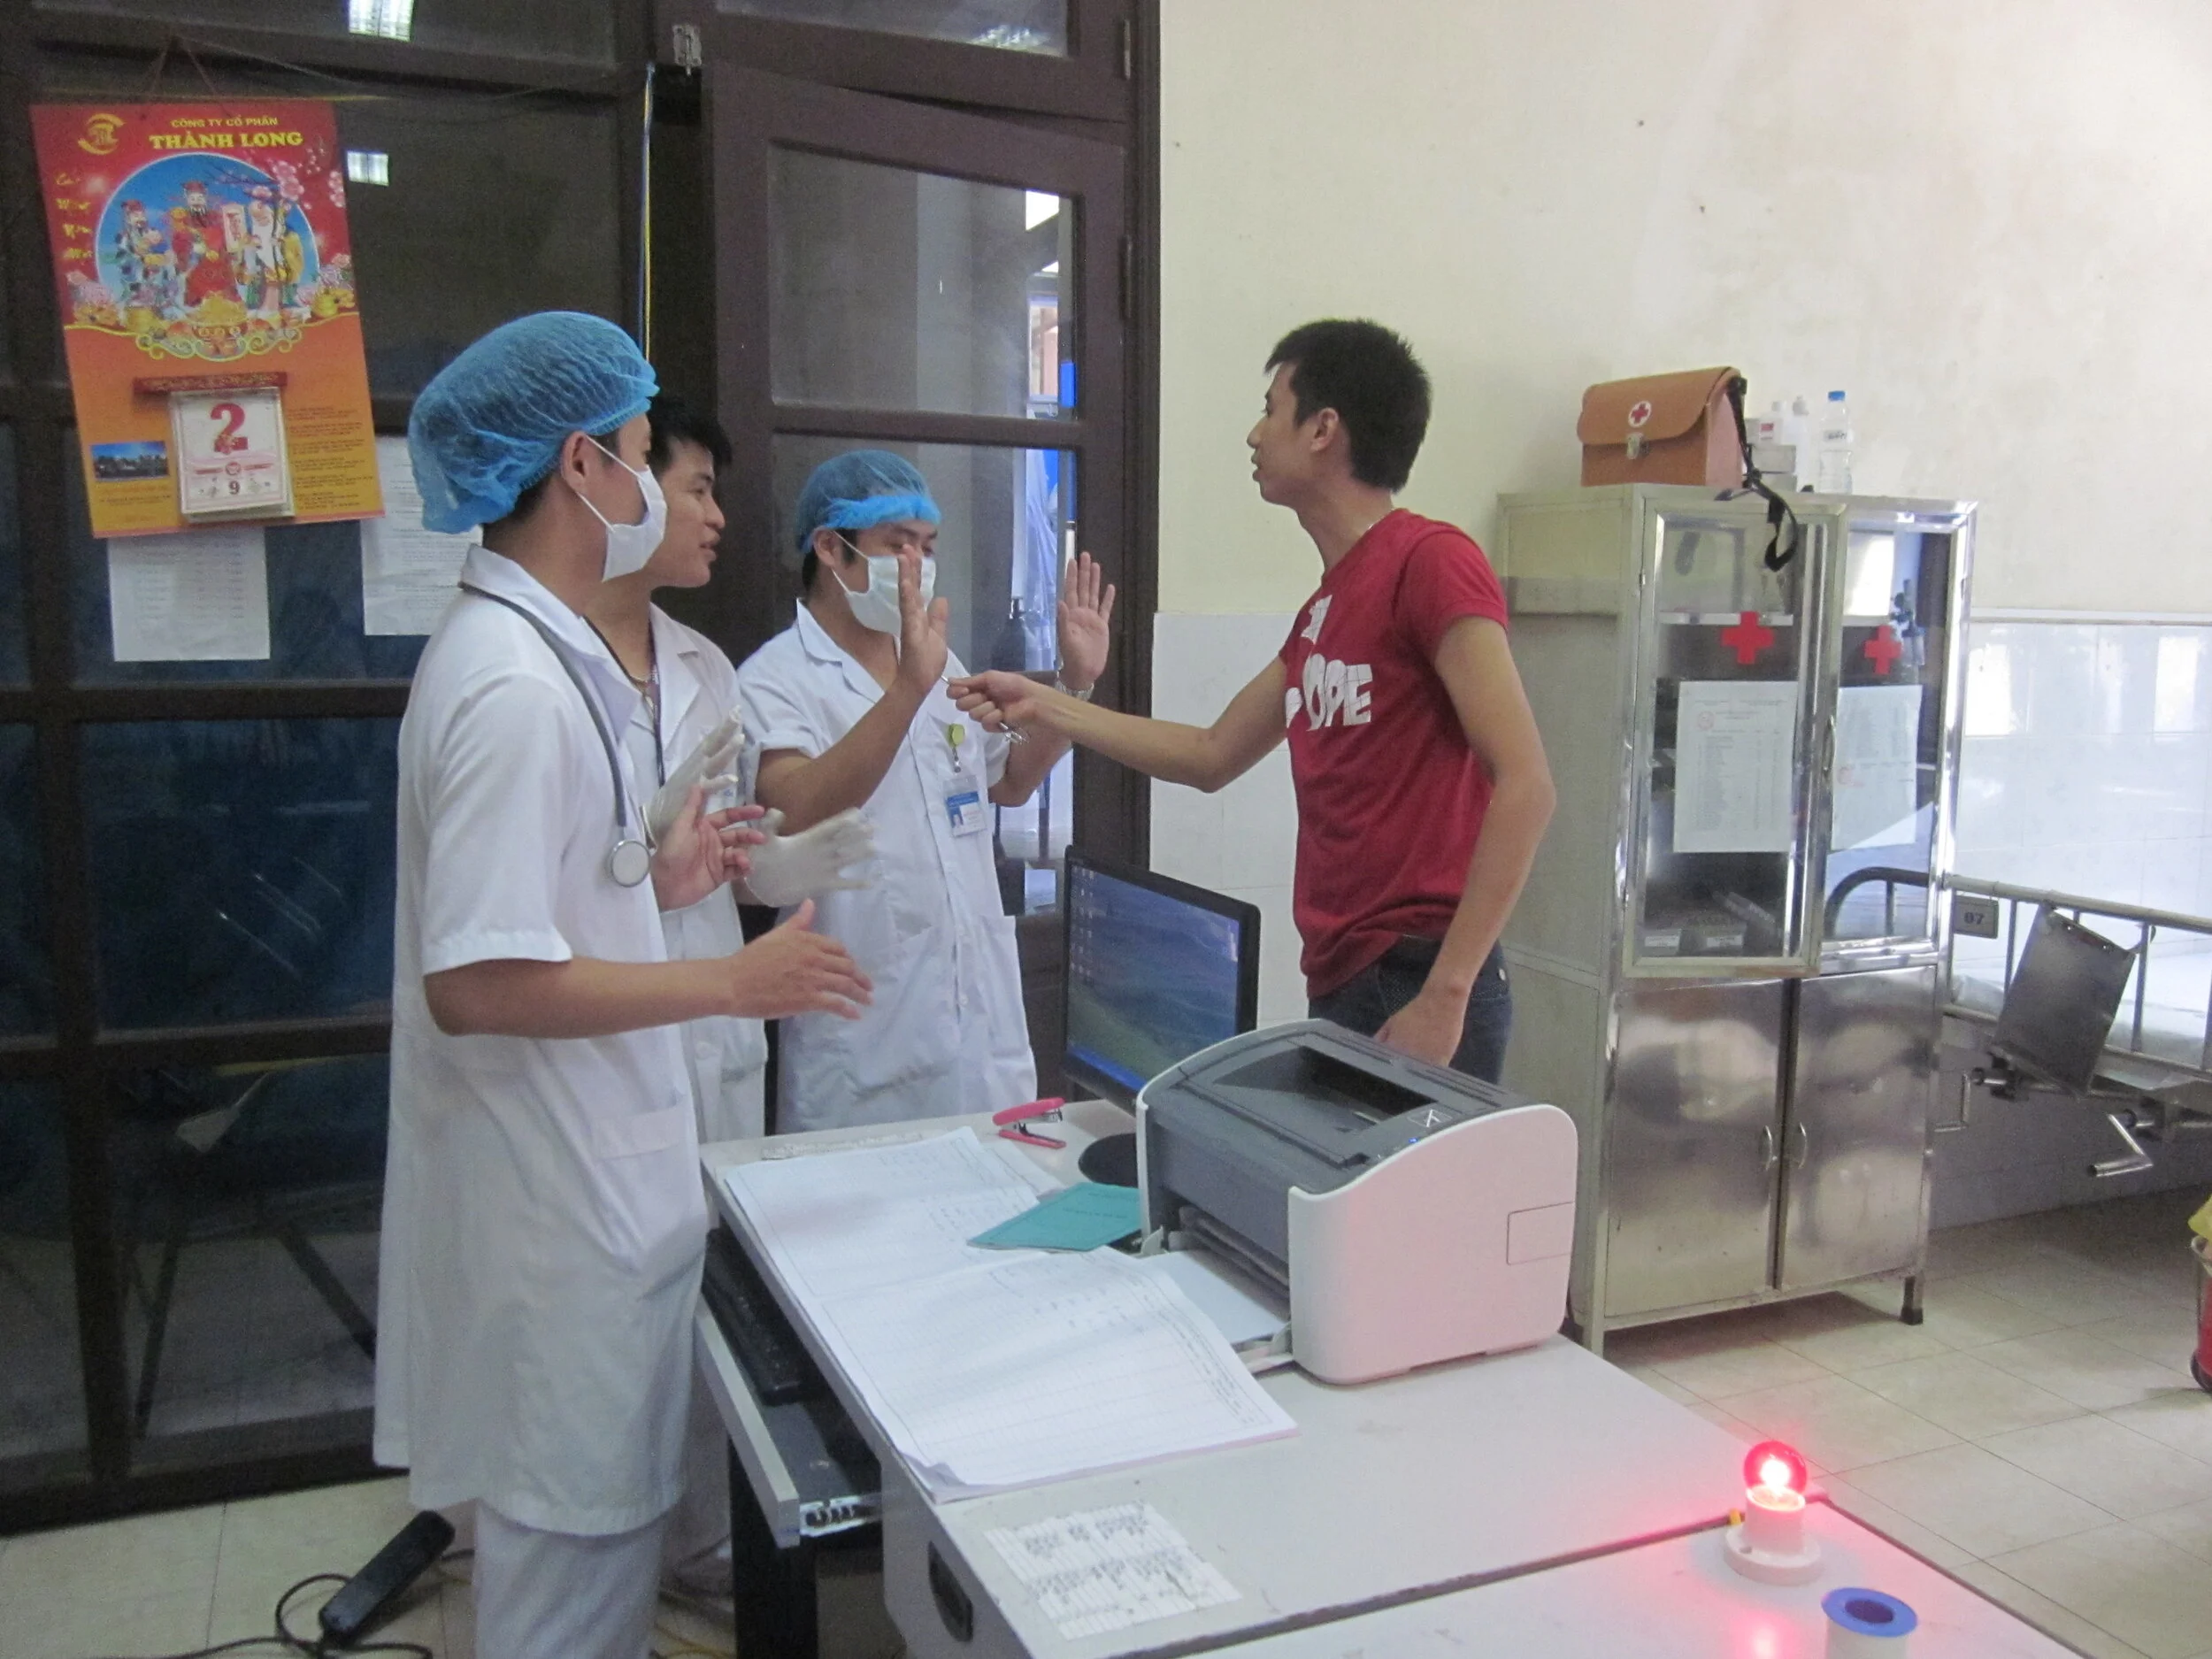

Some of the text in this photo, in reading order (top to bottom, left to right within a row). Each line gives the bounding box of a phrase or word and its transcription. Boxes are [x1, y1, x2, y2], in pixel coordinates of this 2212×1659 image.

[208, 118, 222, 127] TY
[240, 131, 303, 147] LONG
[211, 403, 249, 455] 2
[228, 480, 240, 495] 9
[1964, 911, 1985, 925] 07
